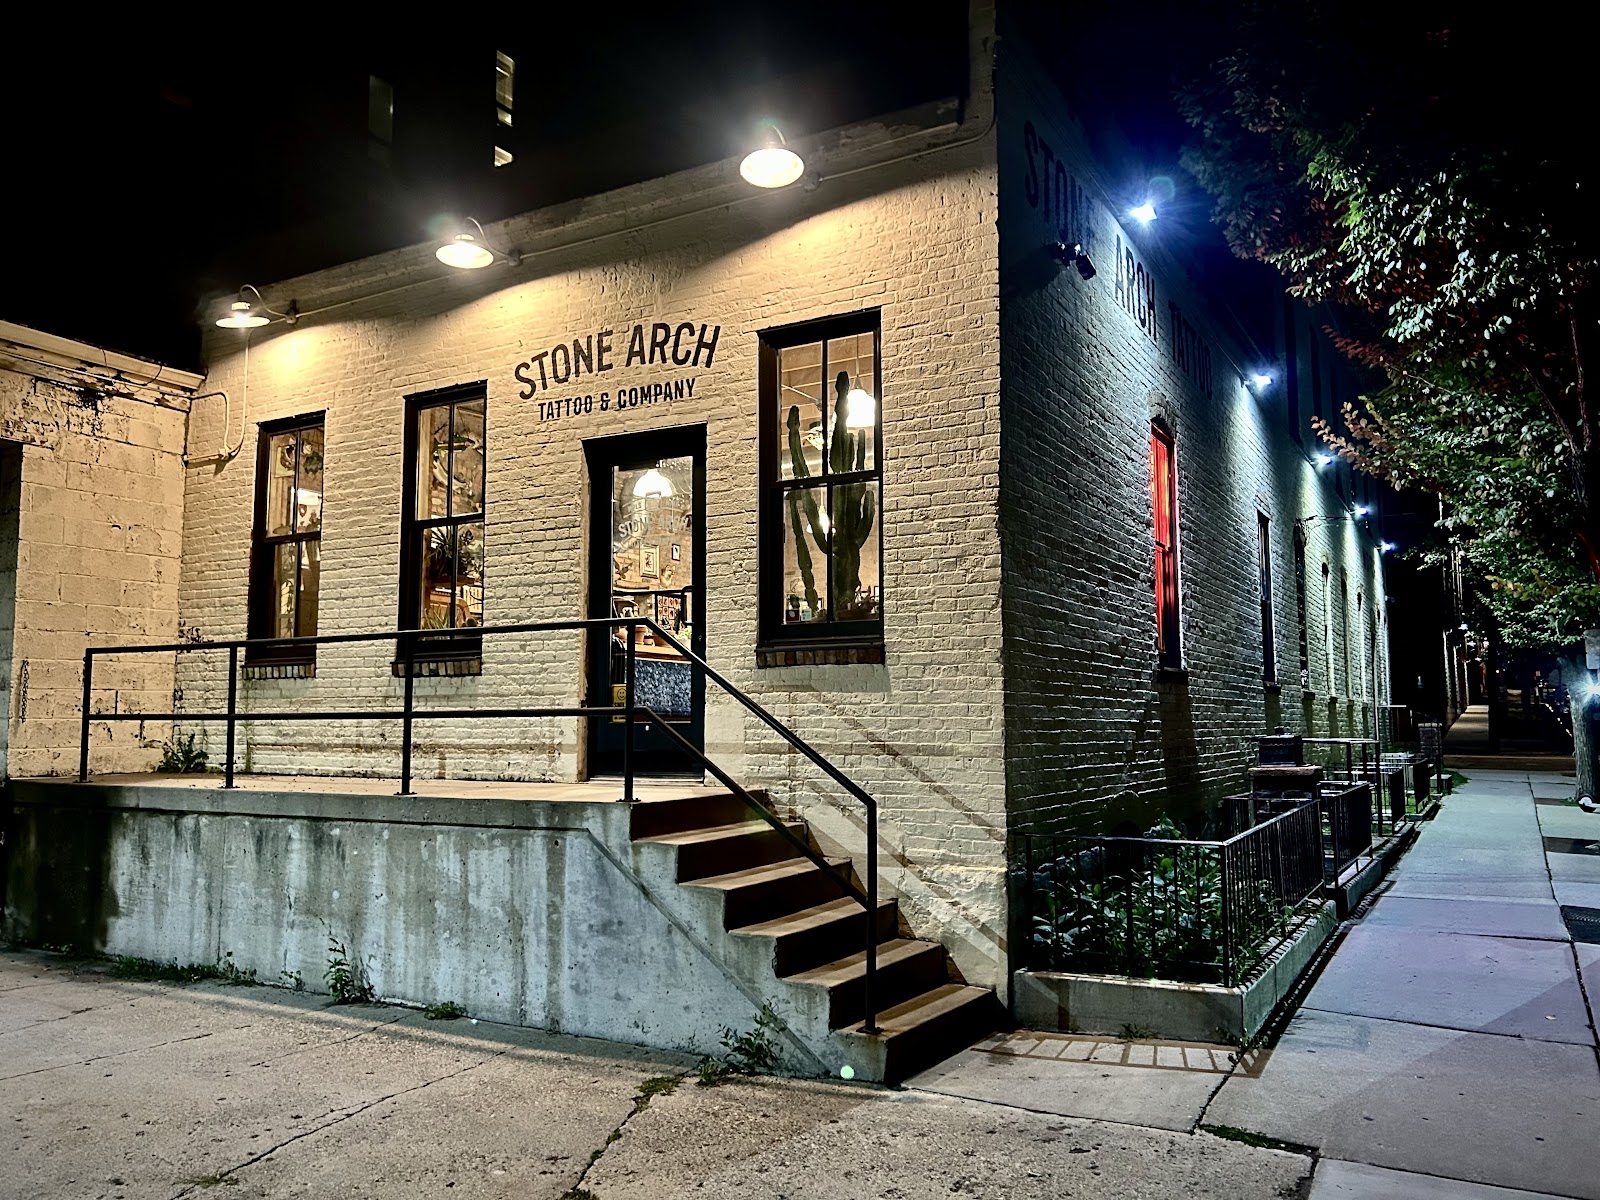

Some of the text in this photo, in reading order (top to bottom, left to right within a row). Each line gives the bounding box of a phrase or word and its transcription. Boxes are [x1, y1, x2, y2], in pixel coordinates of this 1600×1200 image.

[1115, 233, 1157, 342] ARCH
[1168, 299, 1213, 401] TATTOO
[514, 322, 721, 400] STONE ARCH
[538, 378, 696, 421] TATTOO & COMPANY
